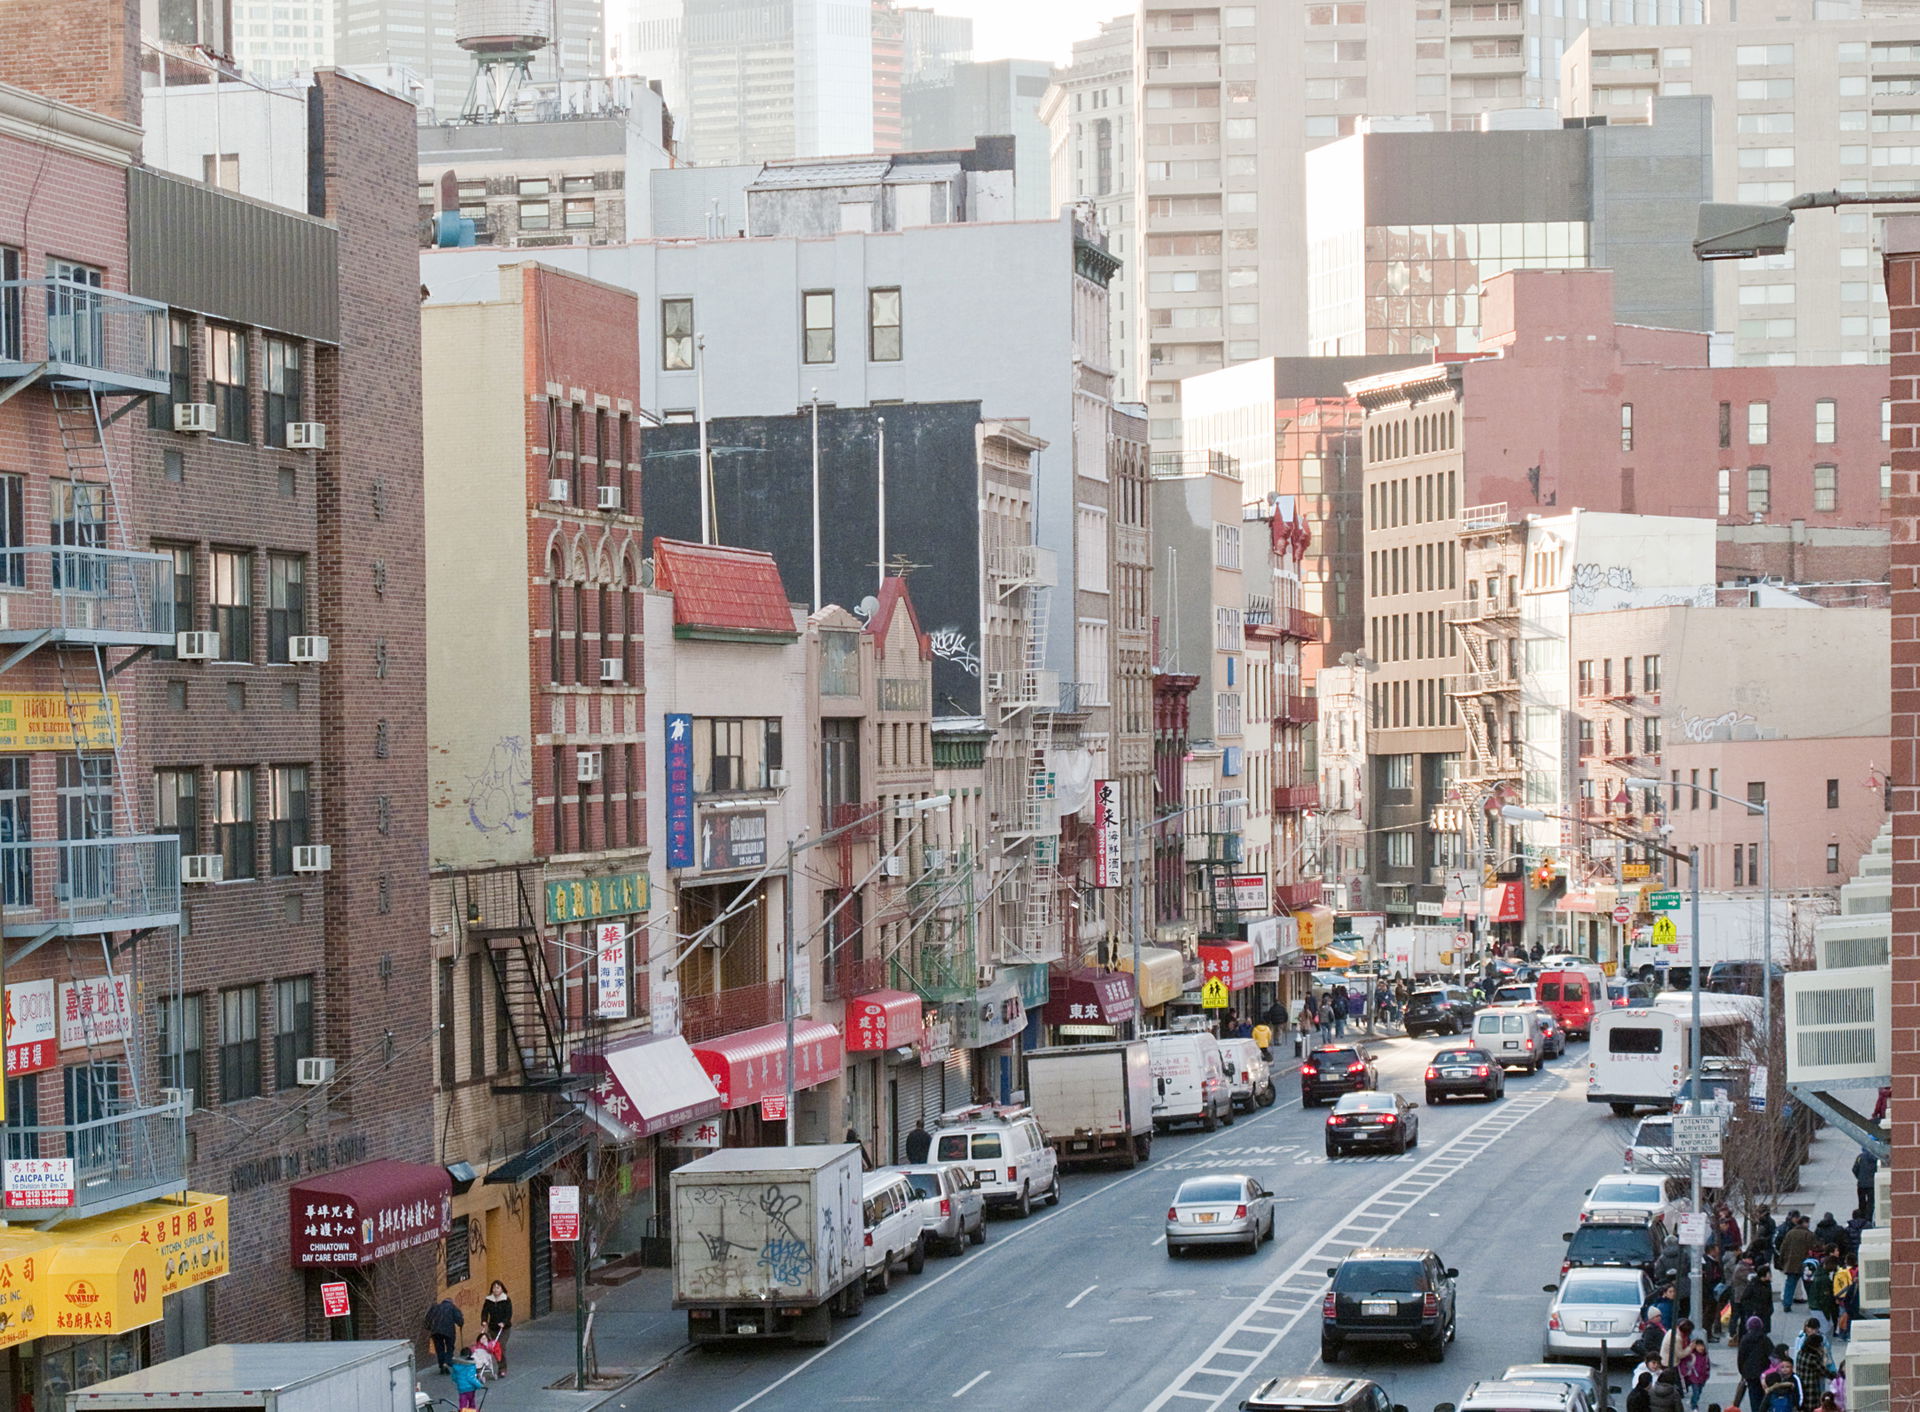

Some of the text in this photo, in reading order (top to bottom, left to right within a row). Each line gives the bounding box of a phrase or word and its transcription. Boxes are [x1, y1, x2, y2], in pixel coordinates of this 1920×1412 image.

[602, 925, 622, 964] 華都
[1069, 1003, 1099, 1020] 東來
[1153, 1158, 1277, 1171] SCHOOL
[14, 1173, 65, 1183] CAICPA PLLC
[140, 1206, 215, 1245] 永昌日用品
[161, 1240, 182, 1256] KITCHEN
[184, 1233, 205, 1249] SUPPLIES
[309, 1243, 350, 1251] CHINATOWN
[374, 1240, 400, 1258] CHINATOWN
[422, 1228, 439, 1243] CENTER
[302, 1254, 313, 1262] DAY
[315, 1254, 331, 1262] CARE
[333, 1253, 357, 1261] CENTER
[133, 1267, 147, 1304] 39
[64, 1294, 100, 1303] SUNRISE
